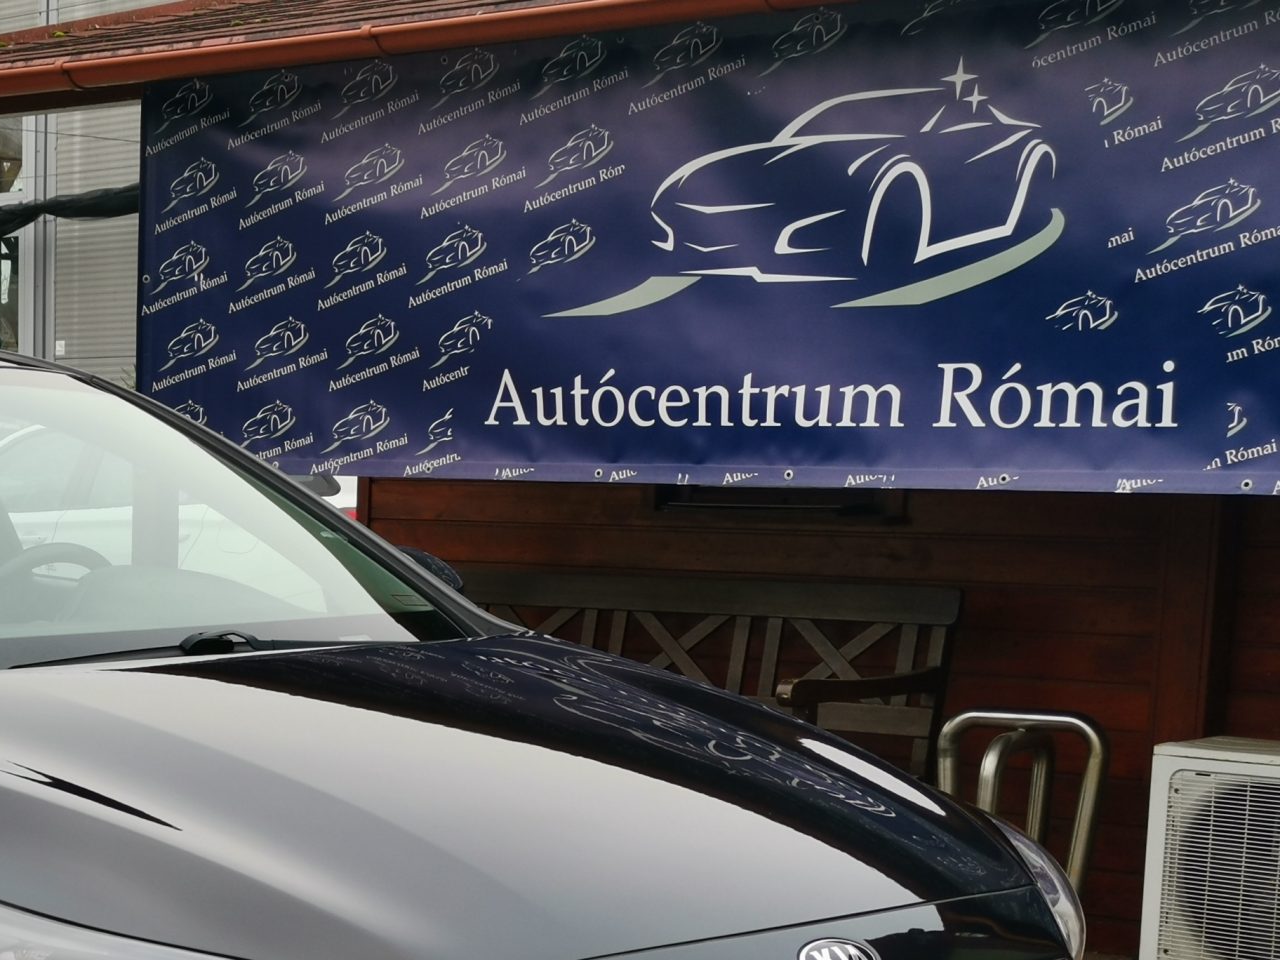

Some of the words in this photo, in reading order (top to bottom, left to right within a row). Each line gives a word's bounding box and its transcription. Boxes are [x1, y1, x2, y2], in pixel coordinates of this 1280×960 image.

[1161, 127, 1266, 172] Autócentrum
[1134, 241, 1235, 283] Autócentrum
[484, 368, 905, 429] Autócentrum
[932, 360, 1179, 430] Római
[1225, 439, 1278, 464] Római
